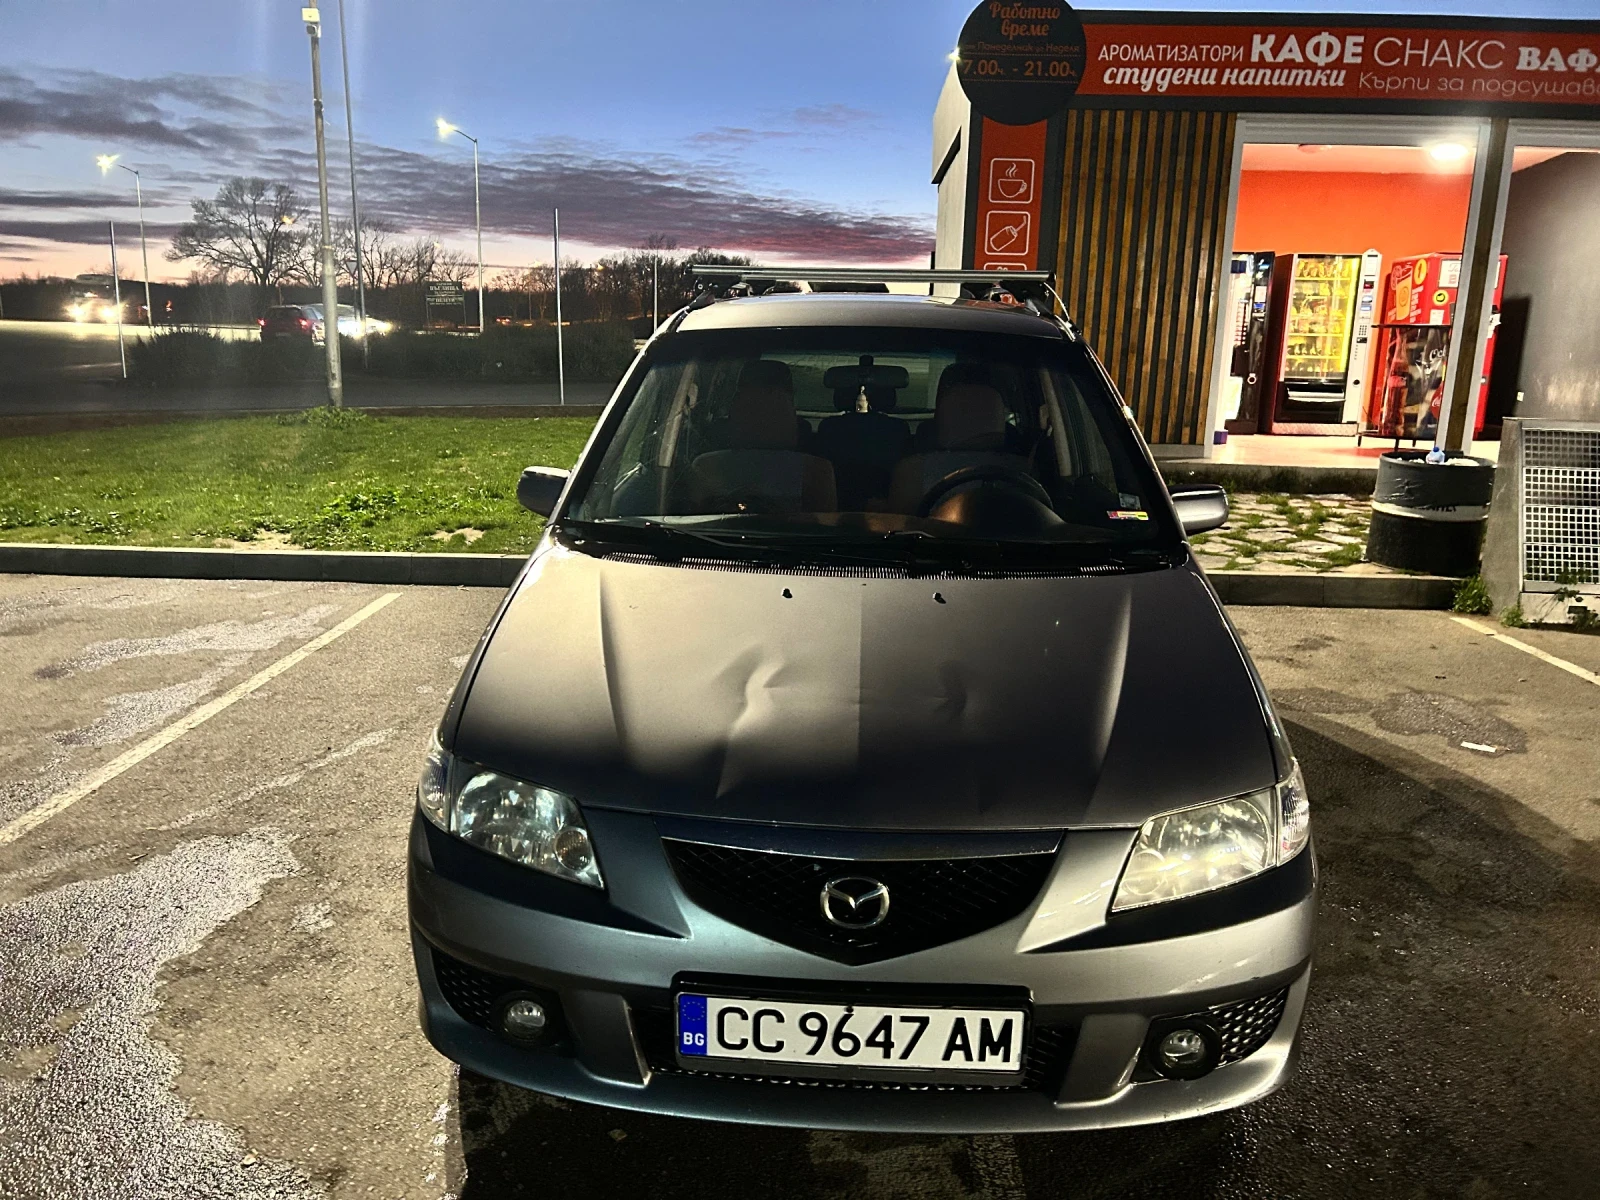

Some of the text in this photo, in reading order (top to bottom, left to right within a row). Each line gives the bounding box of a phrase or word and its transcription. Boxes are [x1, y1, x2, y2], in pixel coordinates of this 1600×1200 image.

[989, 1, 1061, 20] Работно
[1001, 19, 1050, 41] време
[1098, 31, 1600, 73] АРОМАТИЗАТОРИ КАФЕ СНАКС ВАФ
[1102, 65, 1347, 93] студени напитки
[1358, 71, 1430, 94] Кърпи
[1437, 76, 1464, 92] за
[683, 1032, 705, 1046] BG
[716, 1006, 1015, 1063] CC 9647 AM
